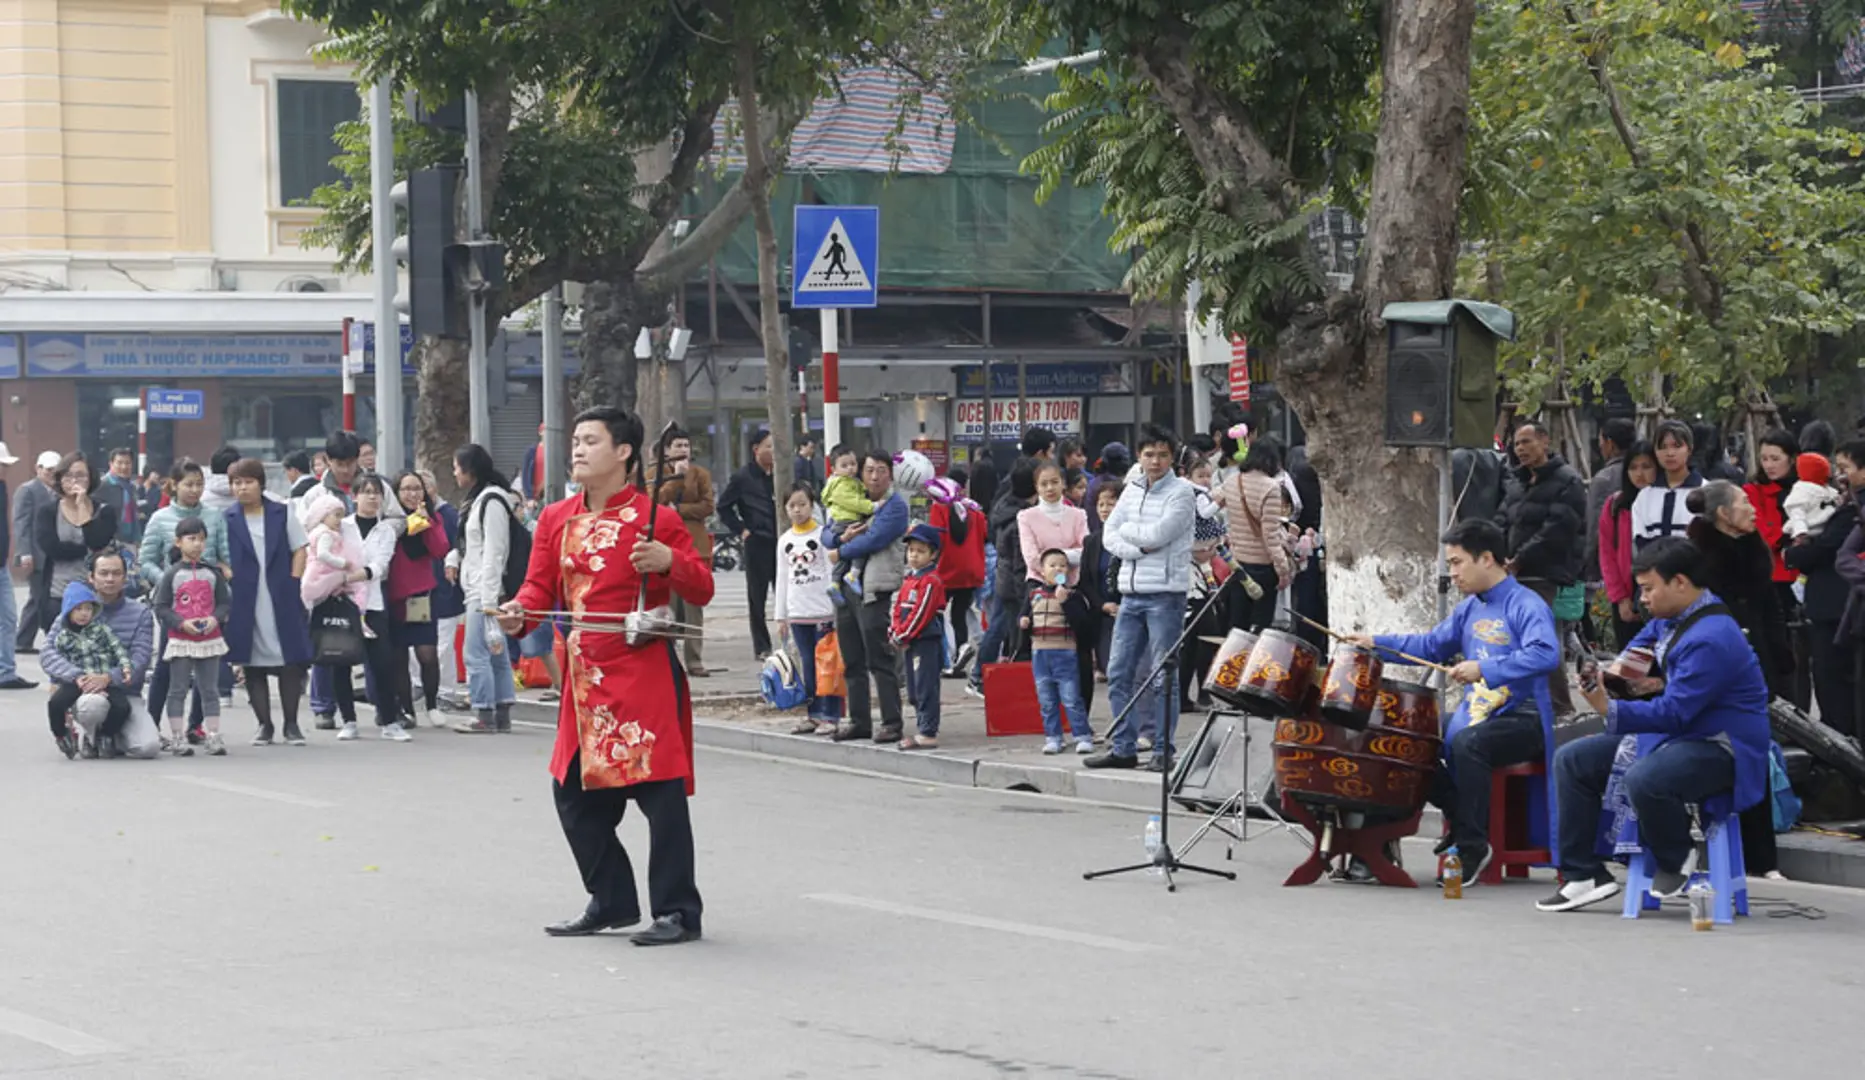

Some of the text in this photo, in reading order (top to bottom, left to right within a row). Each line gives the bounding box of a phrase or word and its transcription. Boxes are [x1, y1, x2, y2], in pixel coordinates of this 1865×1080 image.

[202, 352, 291, 365] HAPHARCO
[997, 371, 1050, 385] Vienam
[1051, 370, 1098, 384] Airlines
[1007, 401, 1042, 422] SAR
[1045, 400, 1080, 421] TOUR
[965, 422, 1022, 433] BOKING
